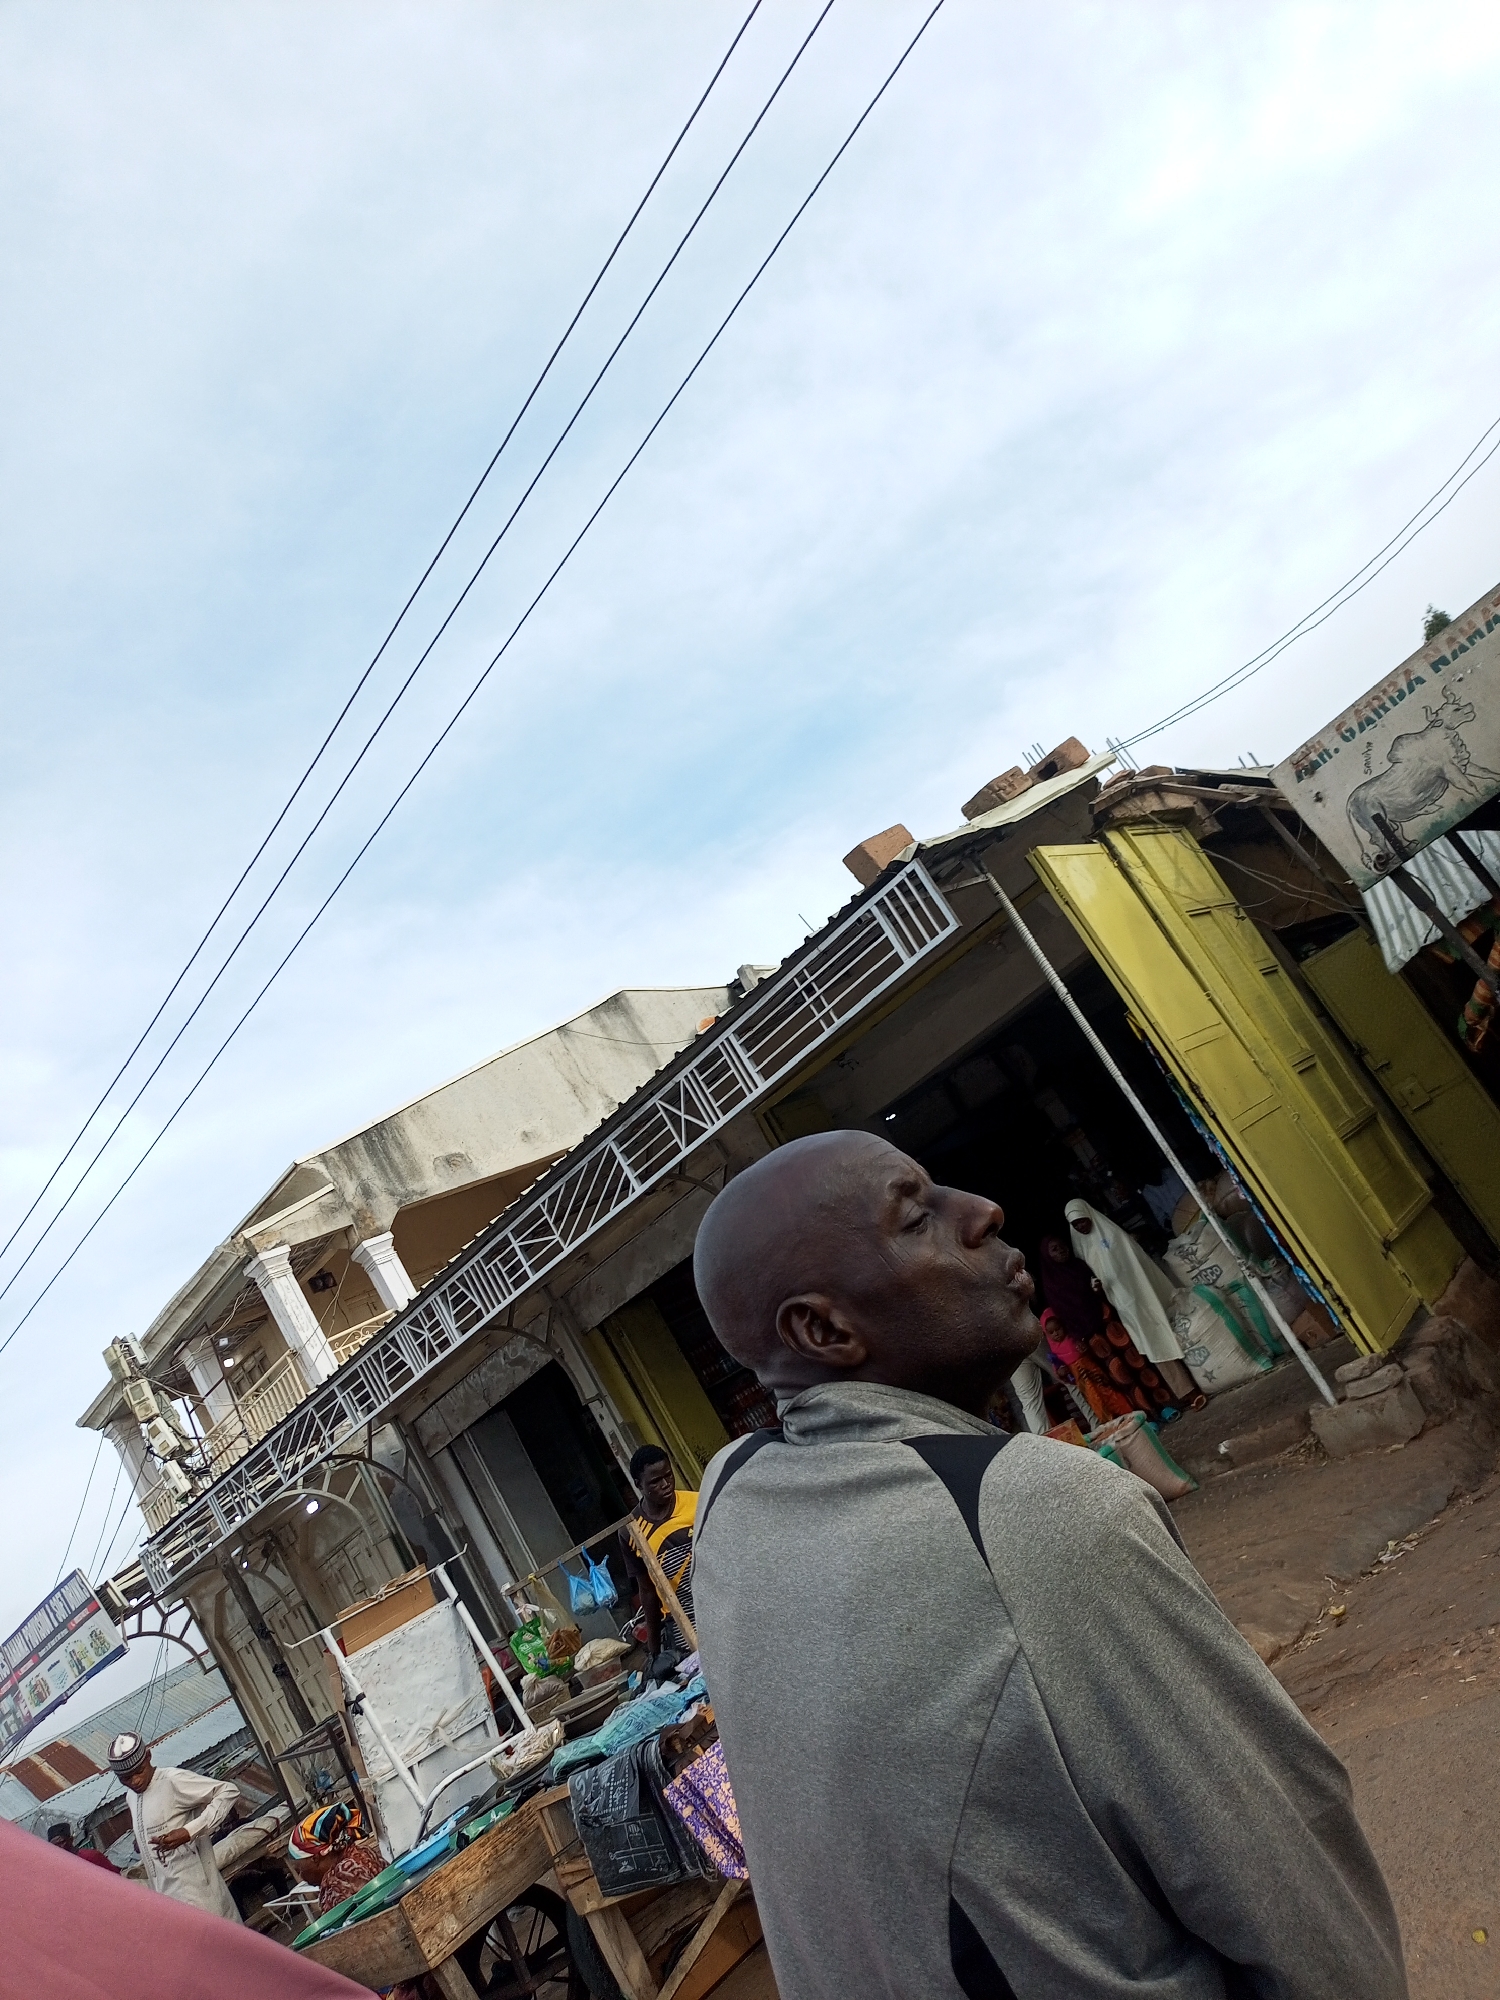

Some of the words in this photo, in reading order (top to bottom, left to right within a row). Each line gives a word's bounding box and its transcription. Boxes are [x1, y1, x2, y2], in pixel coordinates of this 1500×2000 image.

[1335, 668, 1426, 743] GARBA
[1423, 593, 1500, 674] NAMA
[51, 1591, 72, 1623] SOFT
[61, 1575, 91, 1614] DRINKS
